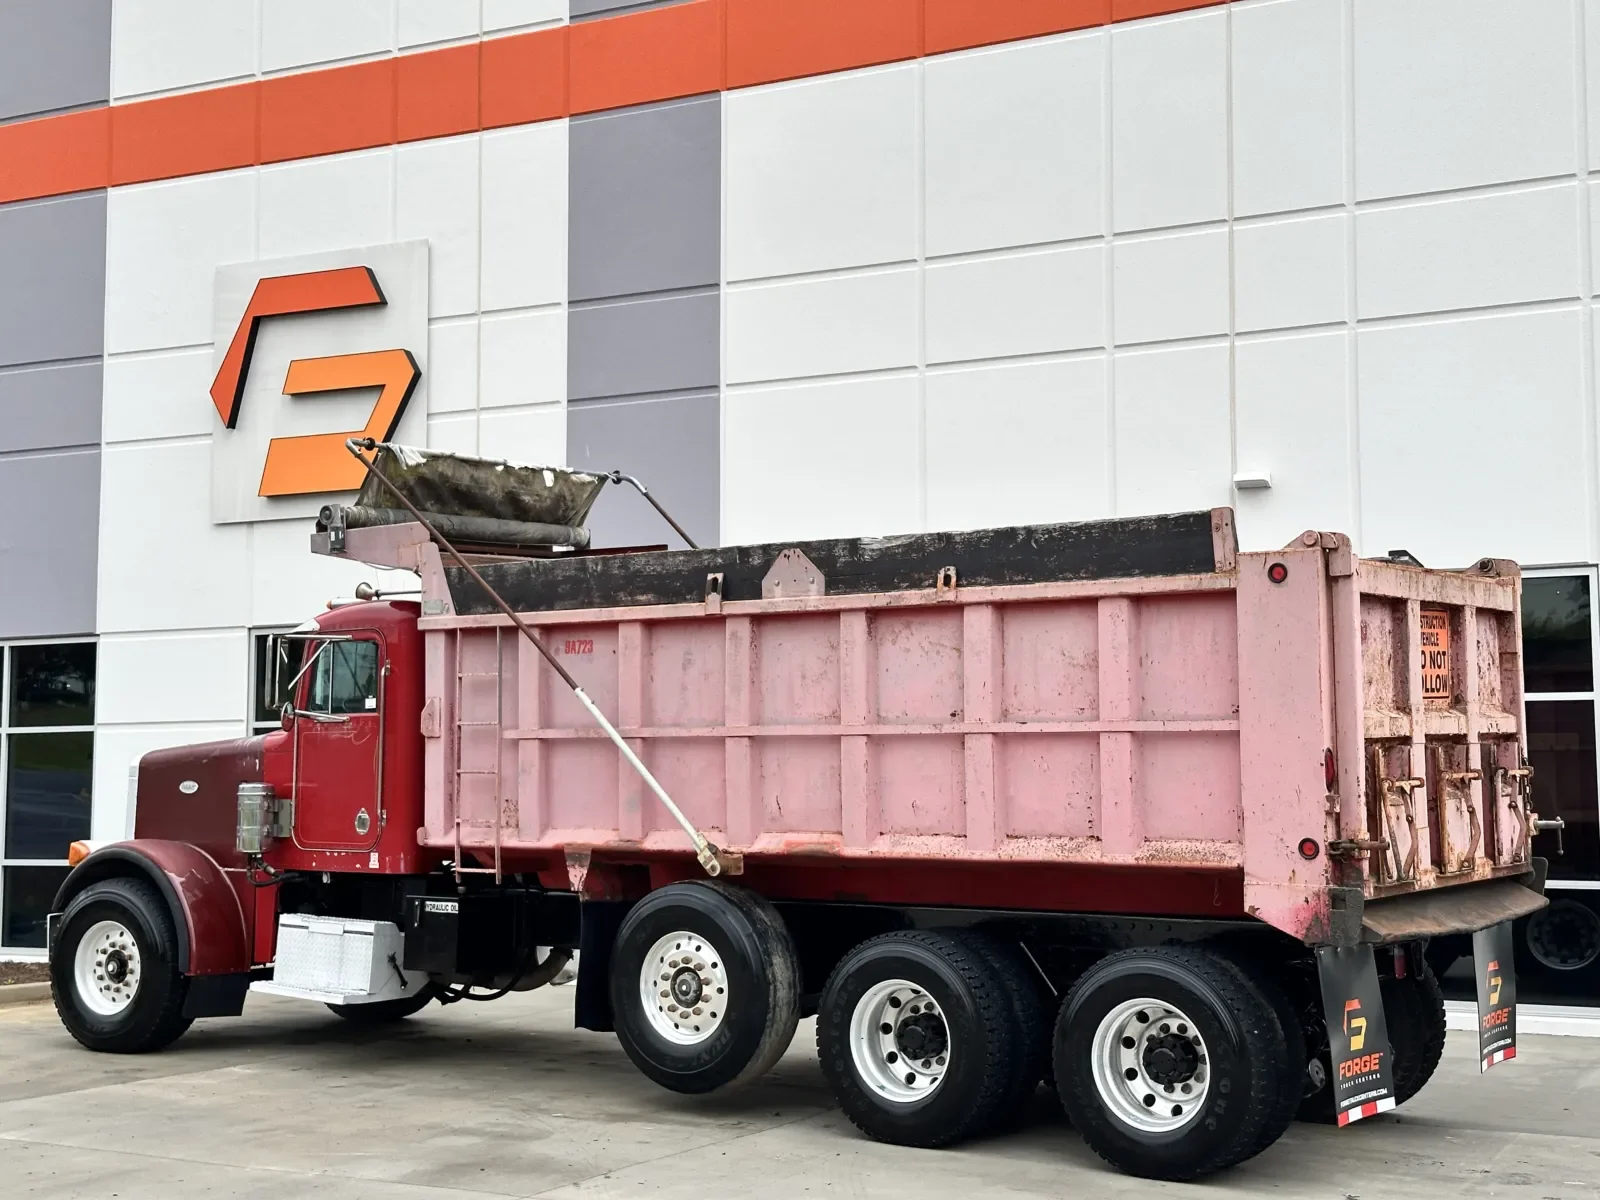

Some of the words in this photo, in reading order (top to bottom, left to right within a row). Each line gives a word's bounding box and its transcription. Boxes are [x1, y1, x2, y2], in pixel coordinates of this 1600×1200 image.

[1420, 615, 1446, 629] STRUCTION
[1421, 650, 1426, 669] O
[1430, 650, 1446, 669] NOT
[1422, 674, 1447, 693] LLOW
[425, 903, 449, 912] YDRAULIC
[1483, 1007, 1509, 1030] FORGE
[1339, 1053, 1380, 1080] FORGE
